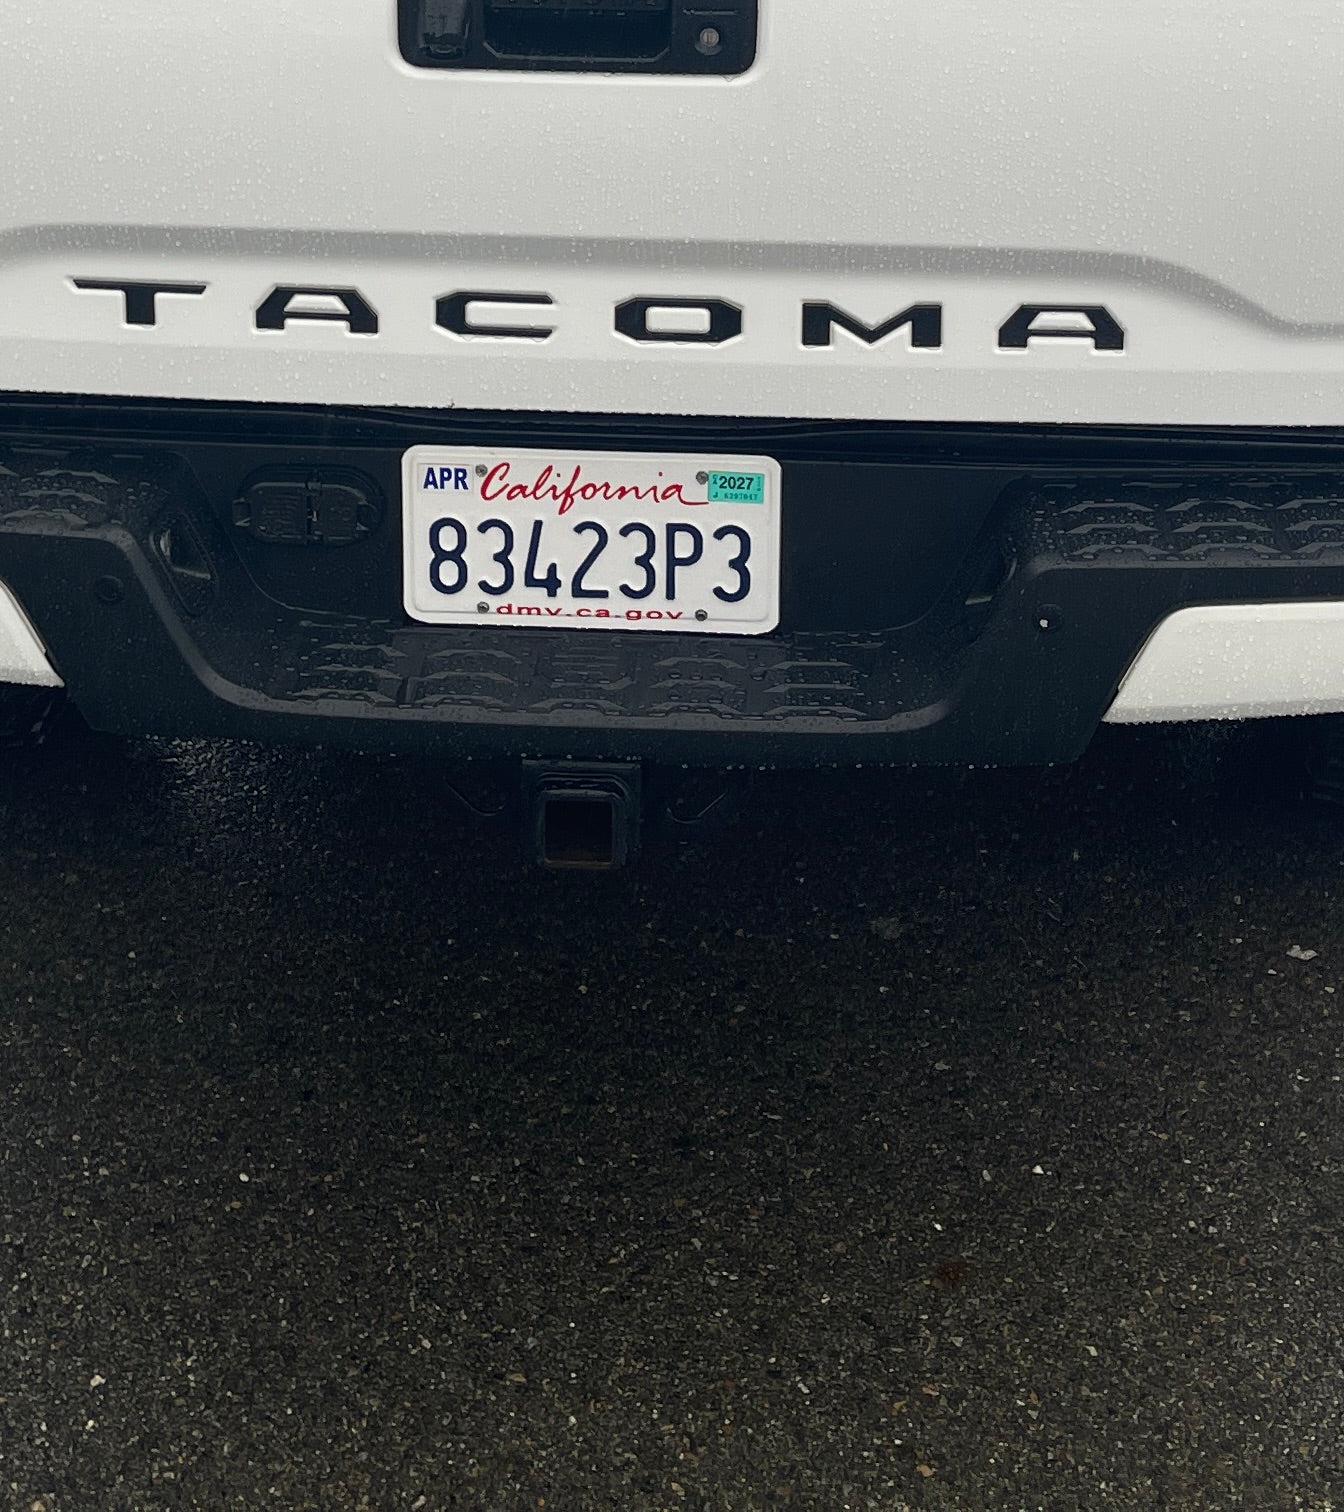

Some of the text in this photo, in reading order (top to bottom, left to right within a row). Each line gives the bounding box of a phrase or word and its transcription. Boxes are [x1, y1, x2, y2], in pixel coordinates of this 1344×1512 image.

[71, 278, 1128, 352] TACOMA
[423, 467, 469, 490] APR
[480, 462, 710, 516] California
[719, 476, 754, 490] 2027
[428, 517, 752, 603] 83423P3
[496, 603, 684, 621] dmv.ca.gov
